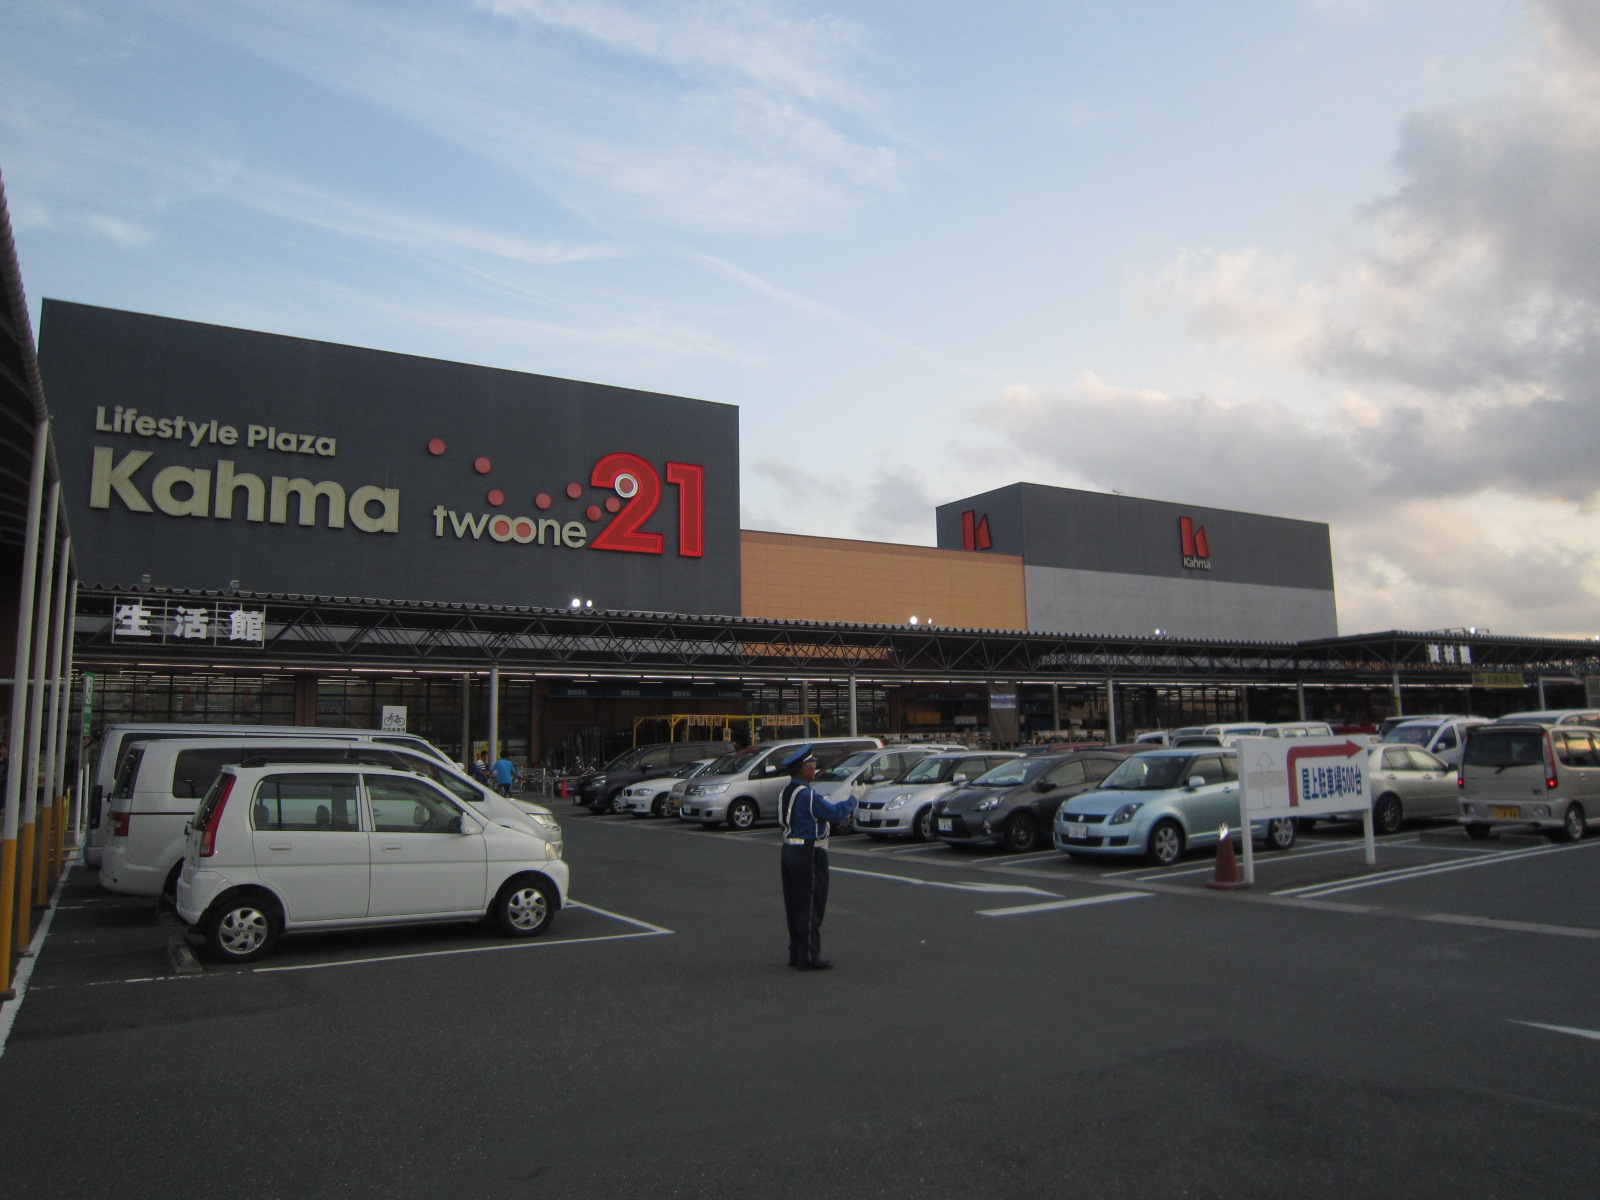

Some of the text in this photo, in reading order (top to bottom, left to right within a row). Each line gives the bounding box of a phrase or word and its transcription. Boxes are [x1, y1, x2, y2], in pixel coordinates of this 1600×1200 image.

[96, 405, 336, 457] Lifestyle Plaza
[90, 446, 400, 534] Kahma
[590, 452, 703, 557] 21
[1183, 556, 1211, 570] Kahma
[115, 604, 264, 642] 生活館
